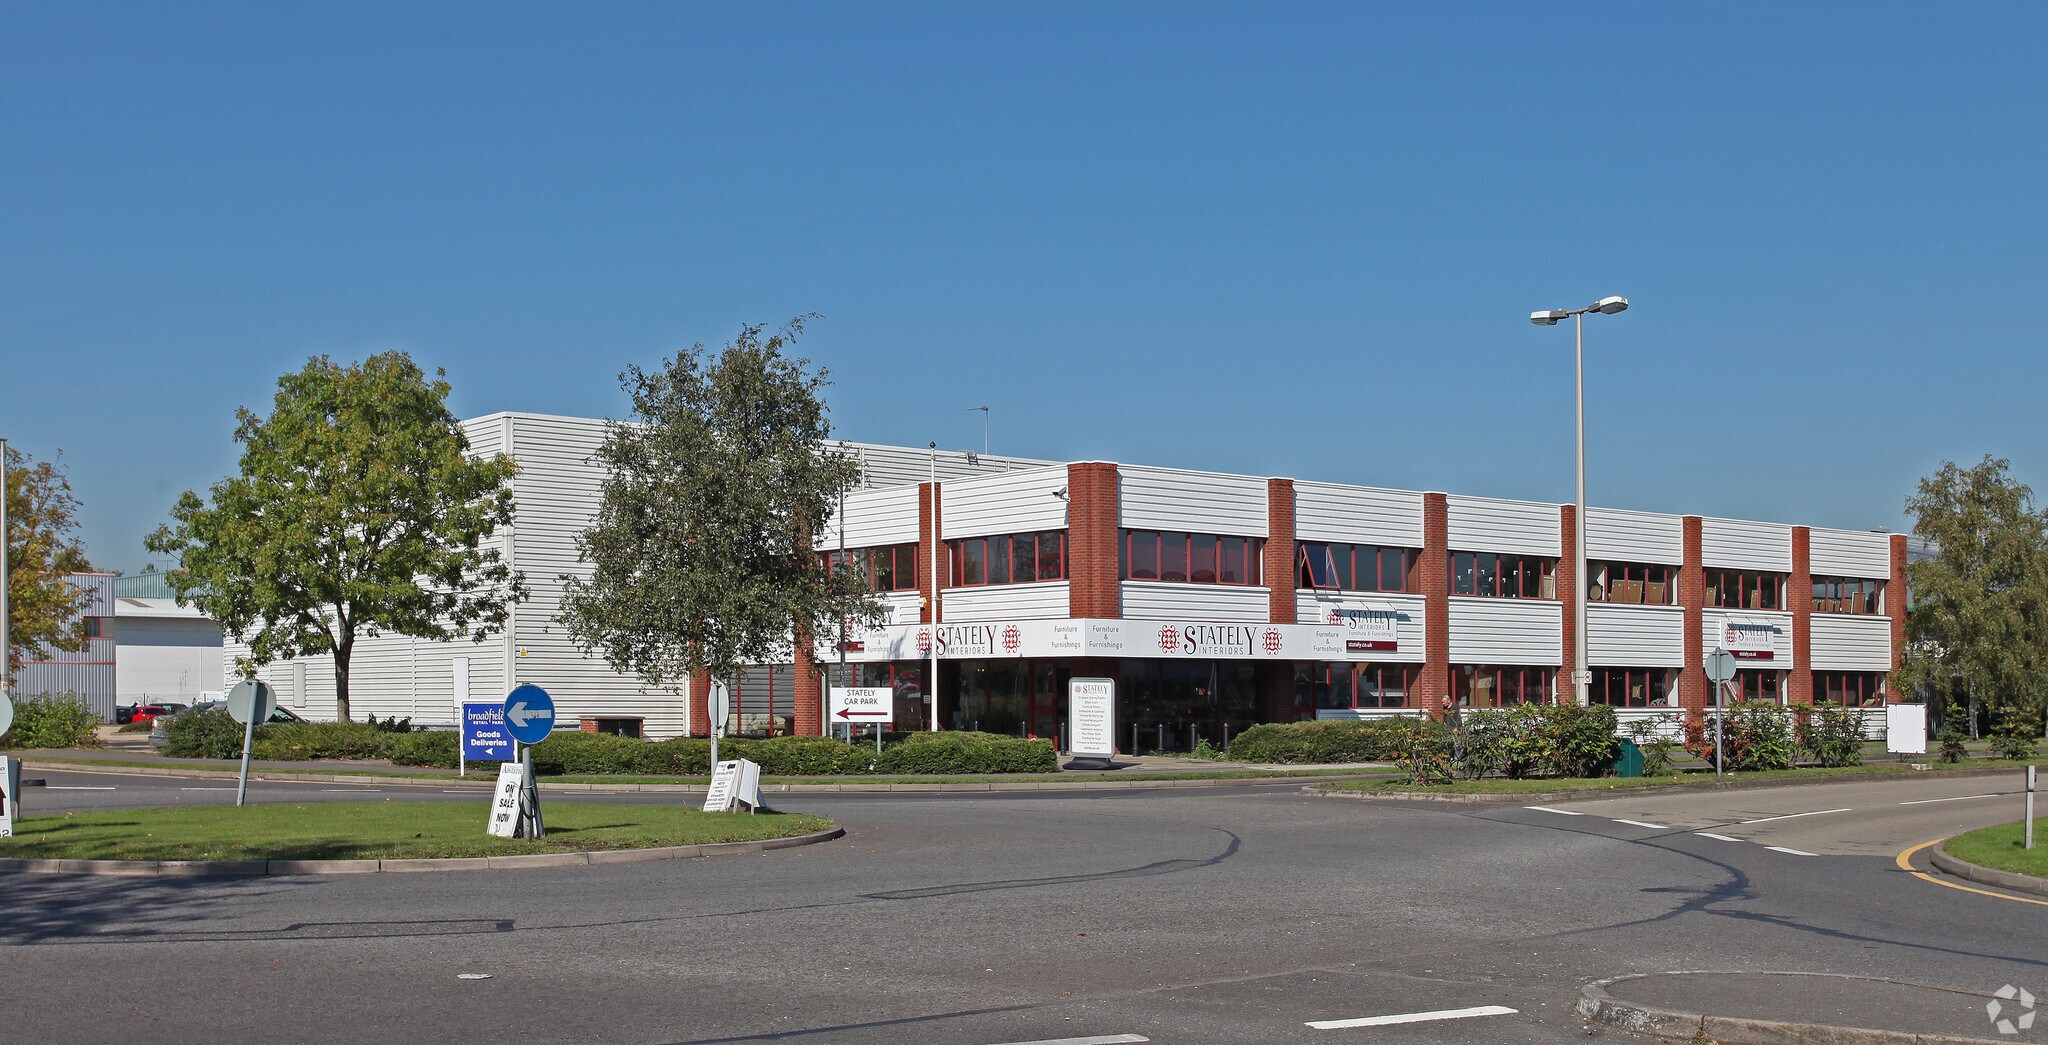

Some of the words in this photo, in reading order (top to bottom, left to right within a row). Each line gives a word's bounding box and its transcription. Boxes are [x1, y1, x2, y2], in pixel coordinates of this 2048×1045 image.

[1349, 610, 1392, 630] STATELY
[1092, 625, 1120, 633] Furniture
[936, 625, 997, 656] STATELY
[1183, 625, 1258, 655] STATELY
[1051, 641, 1081, 649] Furnishings
[1088, 641, 1123, 650] Furnishings
[1313, 645, 1342, 653] Furnishings
[947, 646, 986, 655] INTERIORS
[1198, 646, 1244, 655] INTERIORS
[1082, 684, 1108, 694] STATELY
[505, 784, 515, 793] ON
[499, 798, 514, 808] SALE
[496, 813, 511, 822] NOW
